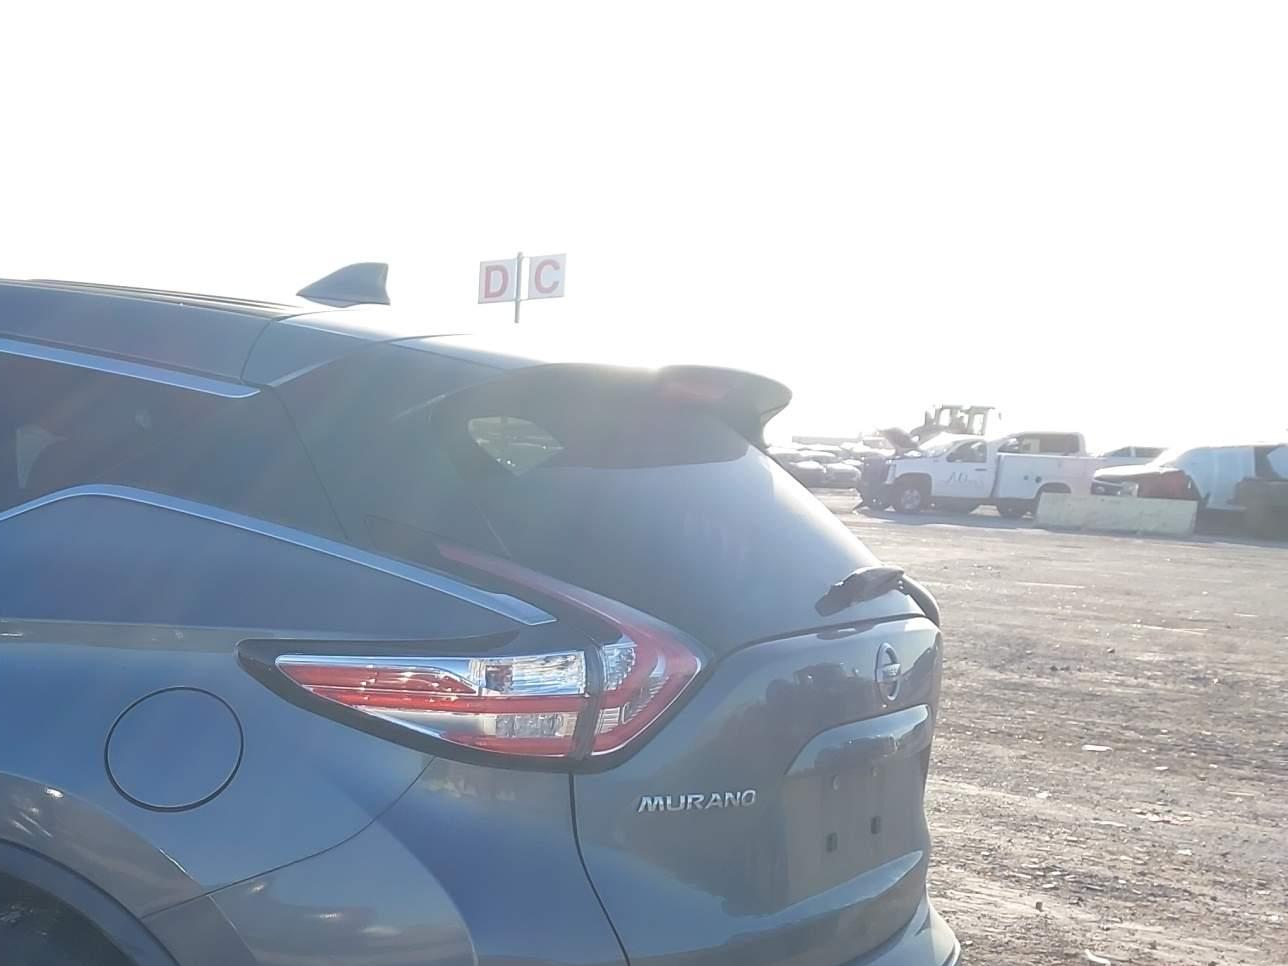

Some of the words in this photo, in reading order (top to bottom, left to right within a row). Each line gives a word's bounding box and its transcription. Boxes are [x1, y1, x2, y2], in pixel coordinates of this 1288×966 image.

[484, 264, 509, 299] D
[534, 258, 560, 294] C
[638, 789, 757, 814] MURANO
